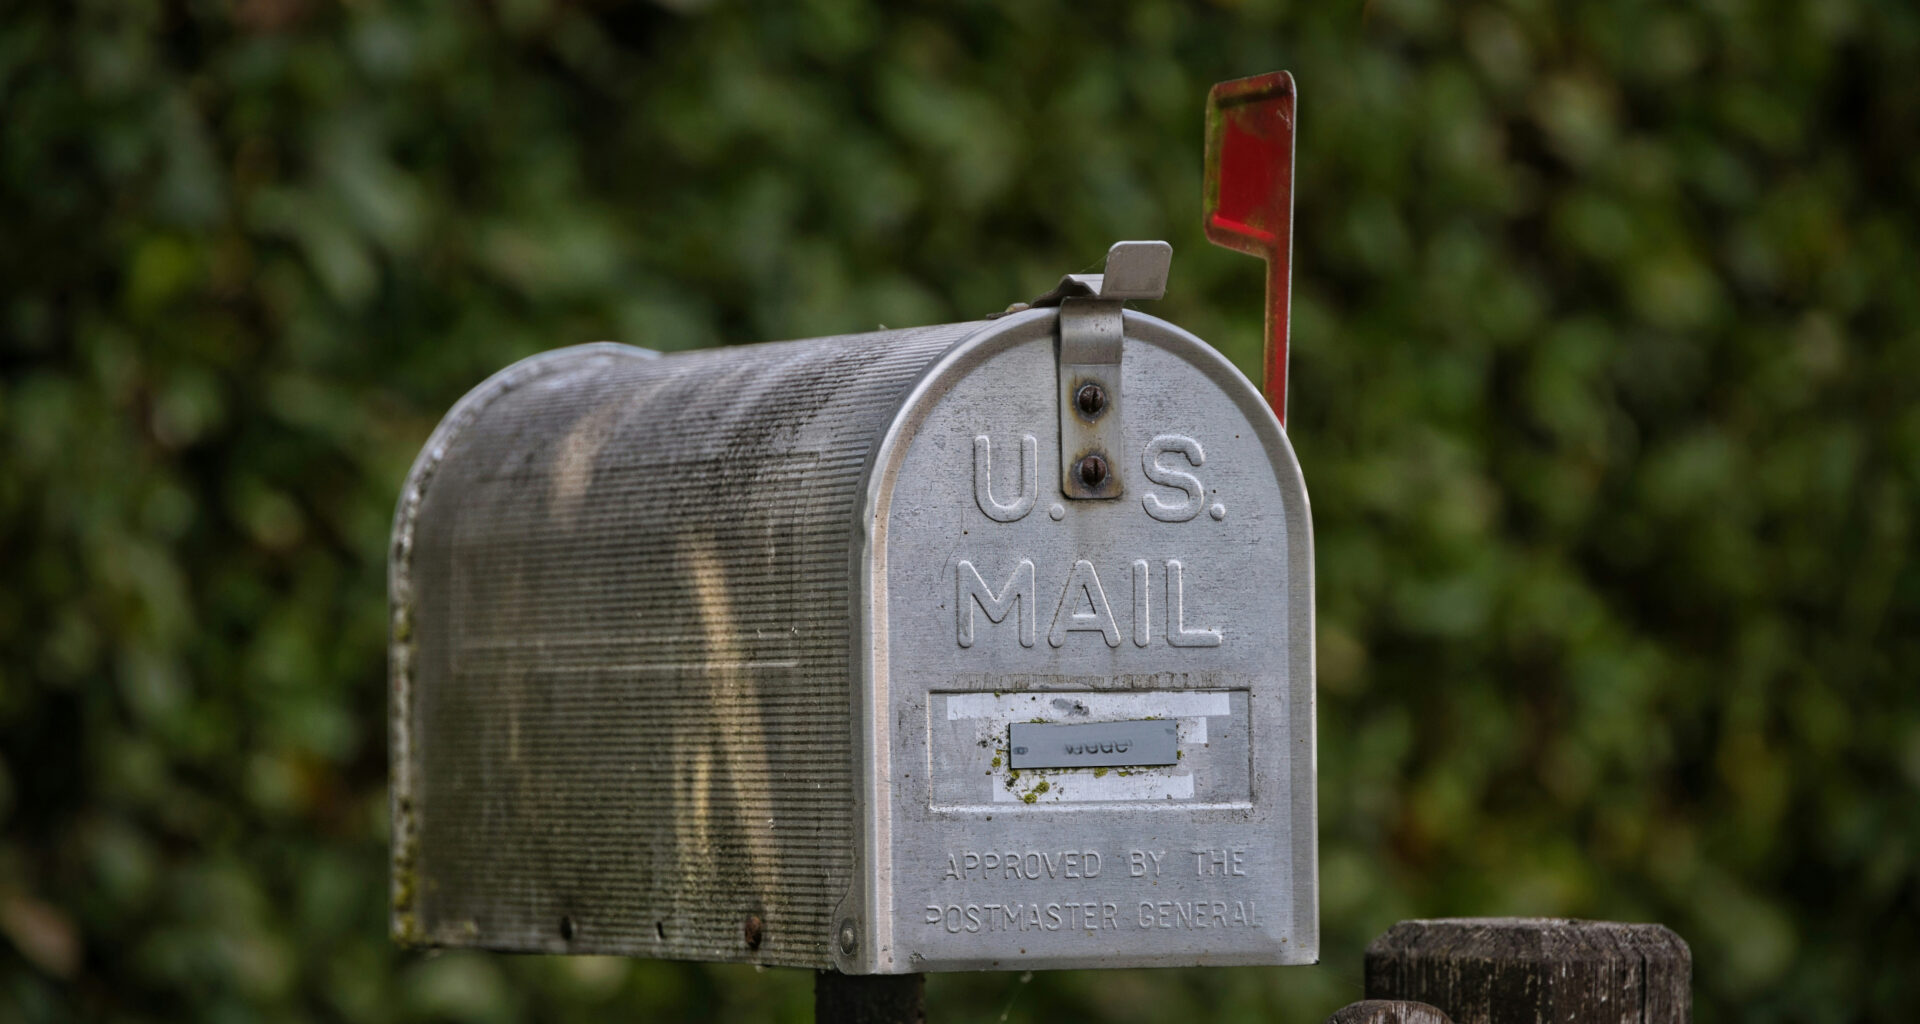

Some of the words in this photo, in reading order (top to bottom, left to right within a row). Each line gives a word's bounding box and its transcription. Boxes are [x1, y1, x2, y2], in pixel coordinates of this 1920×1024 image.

[972, 434, 1065, 523] U.
[1141, 434, 1226, 523] S.
[956, 559, 1223, 649] MAIL
[943, 850, 1101, 880] APPROVED
[1128, 850, 1166, 877] BY
[1194, 850, 1246, 877] THE
[925, 902, 1118, 933] POSTMASTER
[1138, 901, 1264, 929] GENERAL
